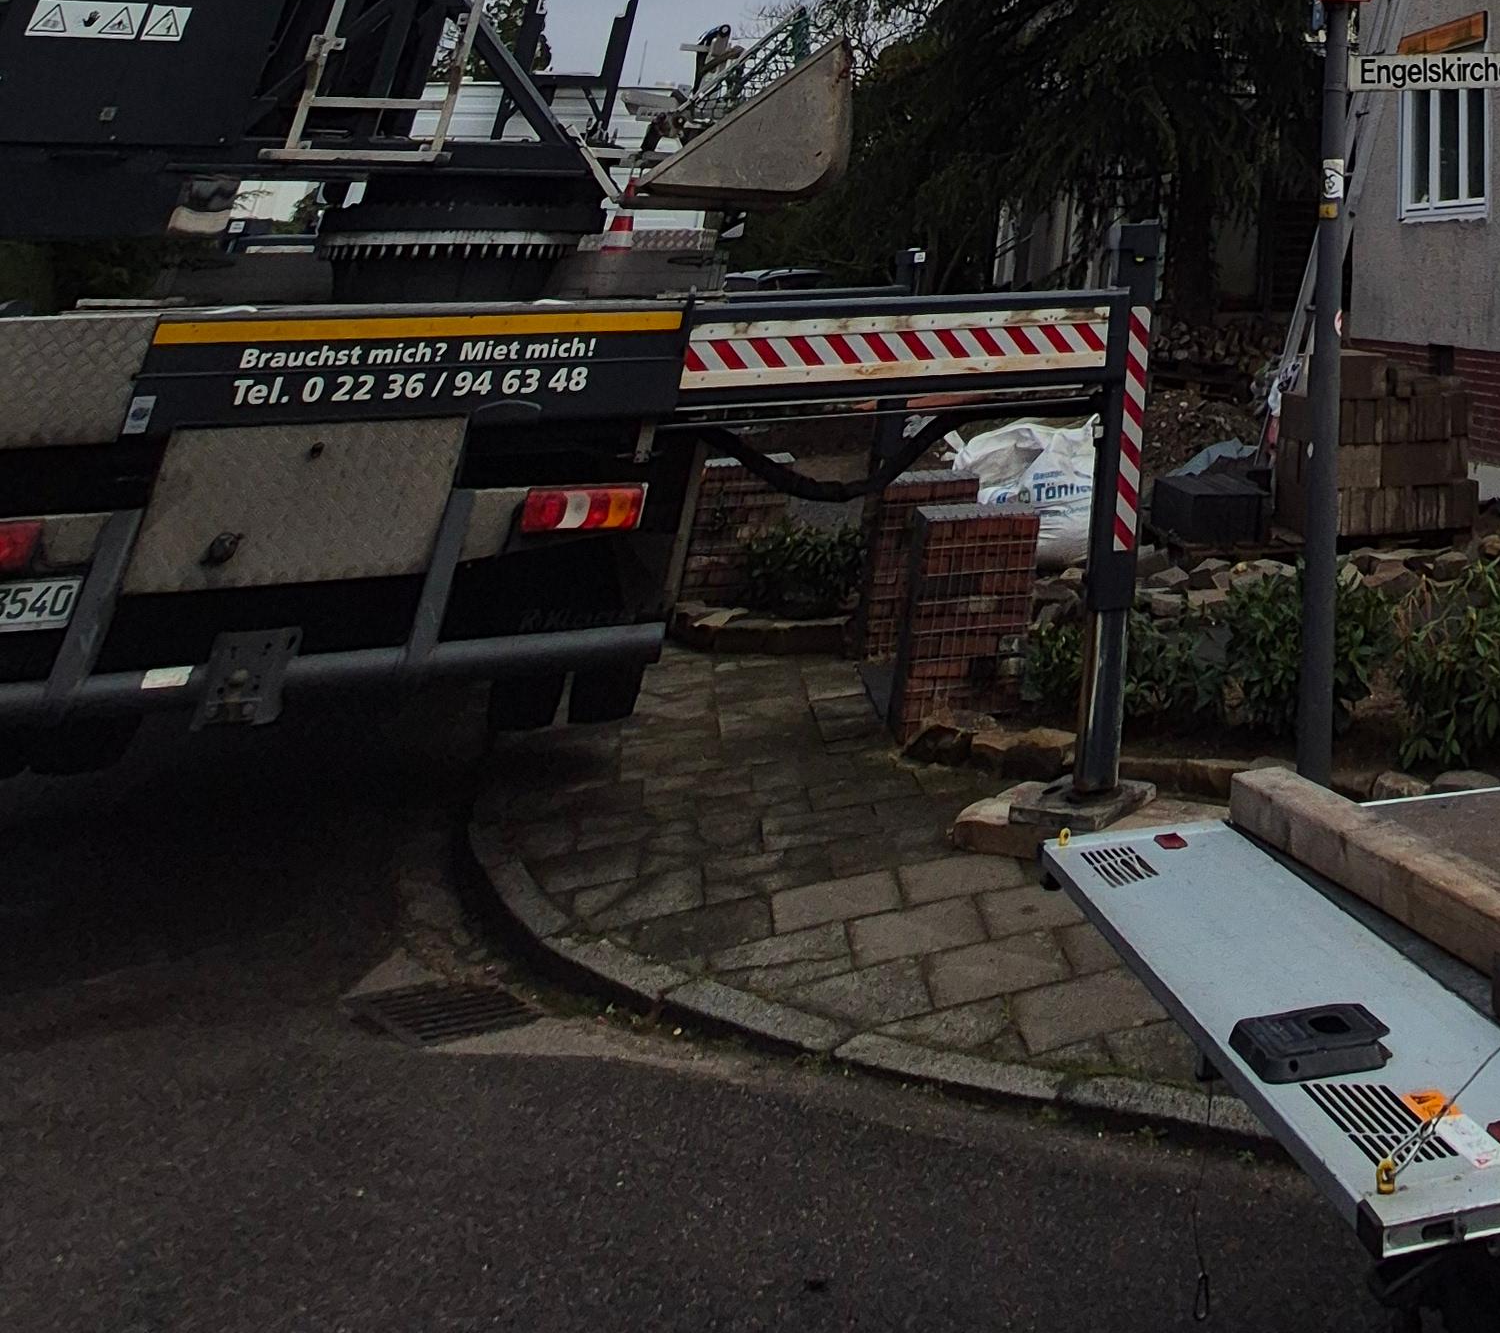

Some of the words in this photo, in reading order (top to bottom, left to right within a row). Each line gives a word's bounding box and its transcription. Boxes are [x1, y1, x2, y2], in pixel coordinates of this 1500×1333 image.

[239, 345, 363, 369] Brauchst
[367, 342, 448, 365] mich?
[459, 340, 520, 362] Miet
[524, 337, 597, 360] mich!
[233, 376, 290, 406] Tel.
[302, 376, 325, 403] 0
[331, 375, 375, 401] 22
[383, 373, 426, 400] 36
[430, 371, 448, 398] /
[452, 370, 493, 397] 94
[502, 368, 541, 395] 63
[548, 366, 589, 393] 48
